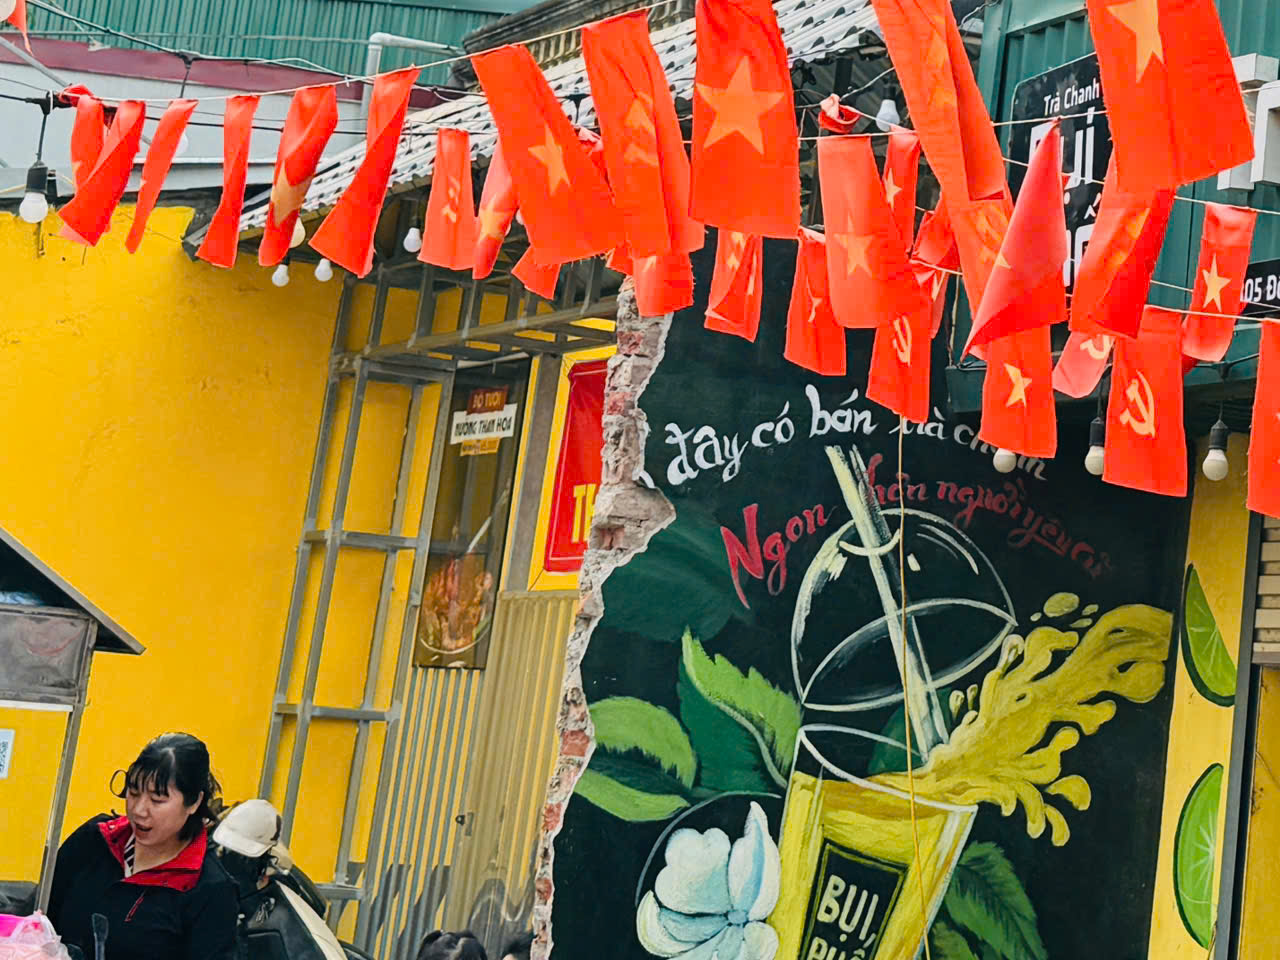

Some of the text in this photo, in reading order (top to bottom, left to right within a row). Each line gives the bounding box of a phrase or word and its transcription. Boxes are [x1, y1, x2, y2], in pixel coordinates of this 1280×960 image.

[1044, 78, 1100, 116] Trà Chanh
[752, 401, 795, 448] có
[805, 384, 879, 438] bán
[720, 503, 838, 609] Ngon
[817, 874, 879, 942] BỤI
